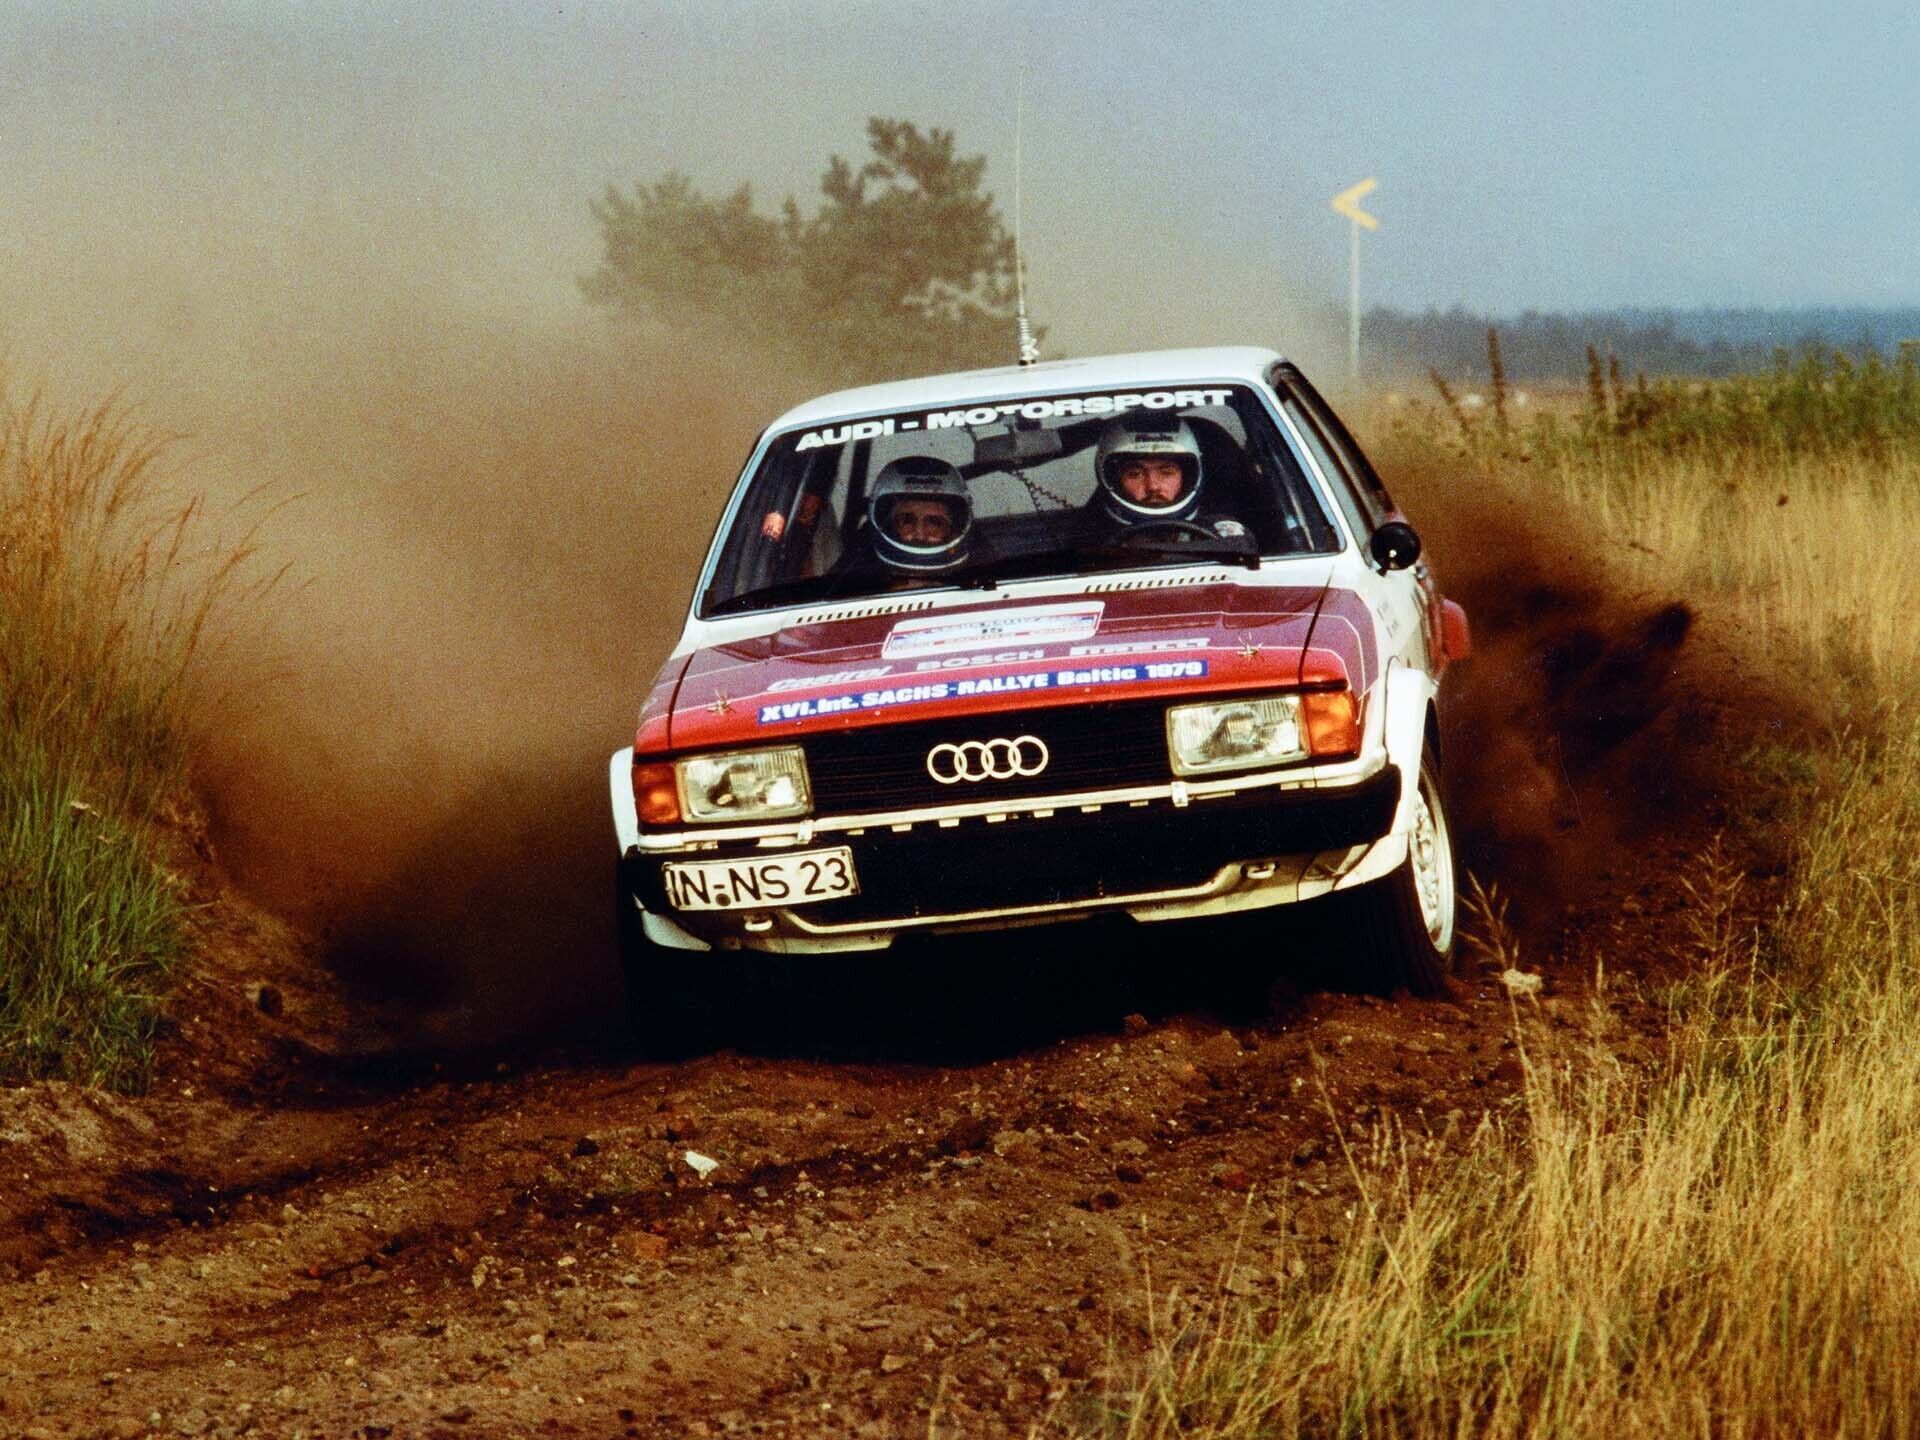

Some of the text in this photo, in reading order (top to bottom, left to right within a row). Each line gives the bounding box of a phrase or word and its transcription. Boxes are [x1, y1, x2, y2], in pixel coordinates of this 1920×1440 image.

[916, 649, 1044, 670] BOSCH
[1057, 668, 1136, 685] Baltic
[1145, 661, 1203, 678] 1979
[800, 858, 850, 895] 23
